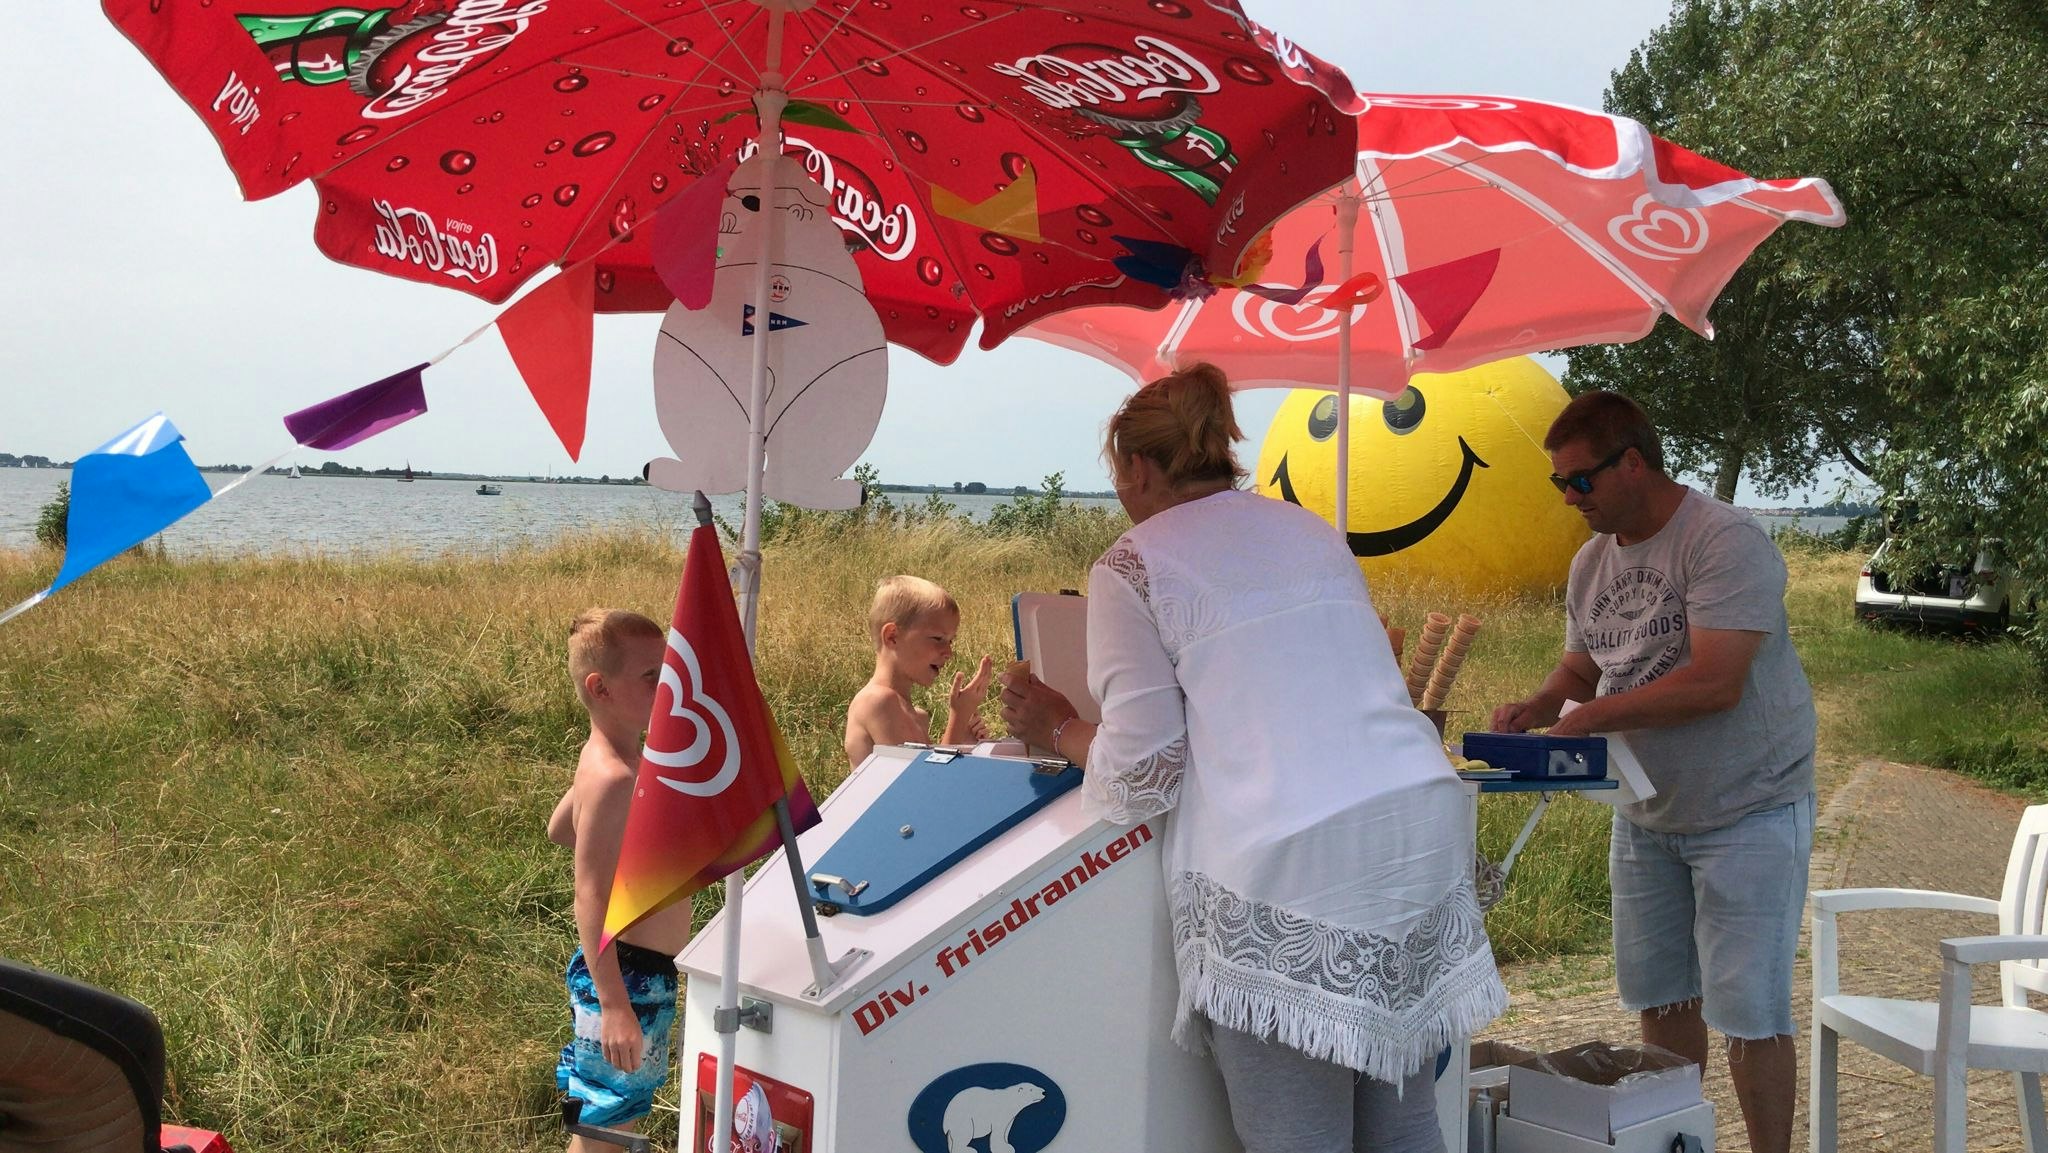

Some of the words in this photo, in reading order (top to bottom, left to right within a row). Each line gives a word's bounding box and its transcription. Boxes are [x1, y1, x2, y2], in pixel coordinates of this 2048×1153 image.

[1590, 595, 1612, 623] JOHN
[1637, 570, 1663, 589] DNIM
[1609, 587, 1637, 616] SUPPY
[852, 980, 930, 1037] Div.
[935, 823, 1154, 978] frisdranken
